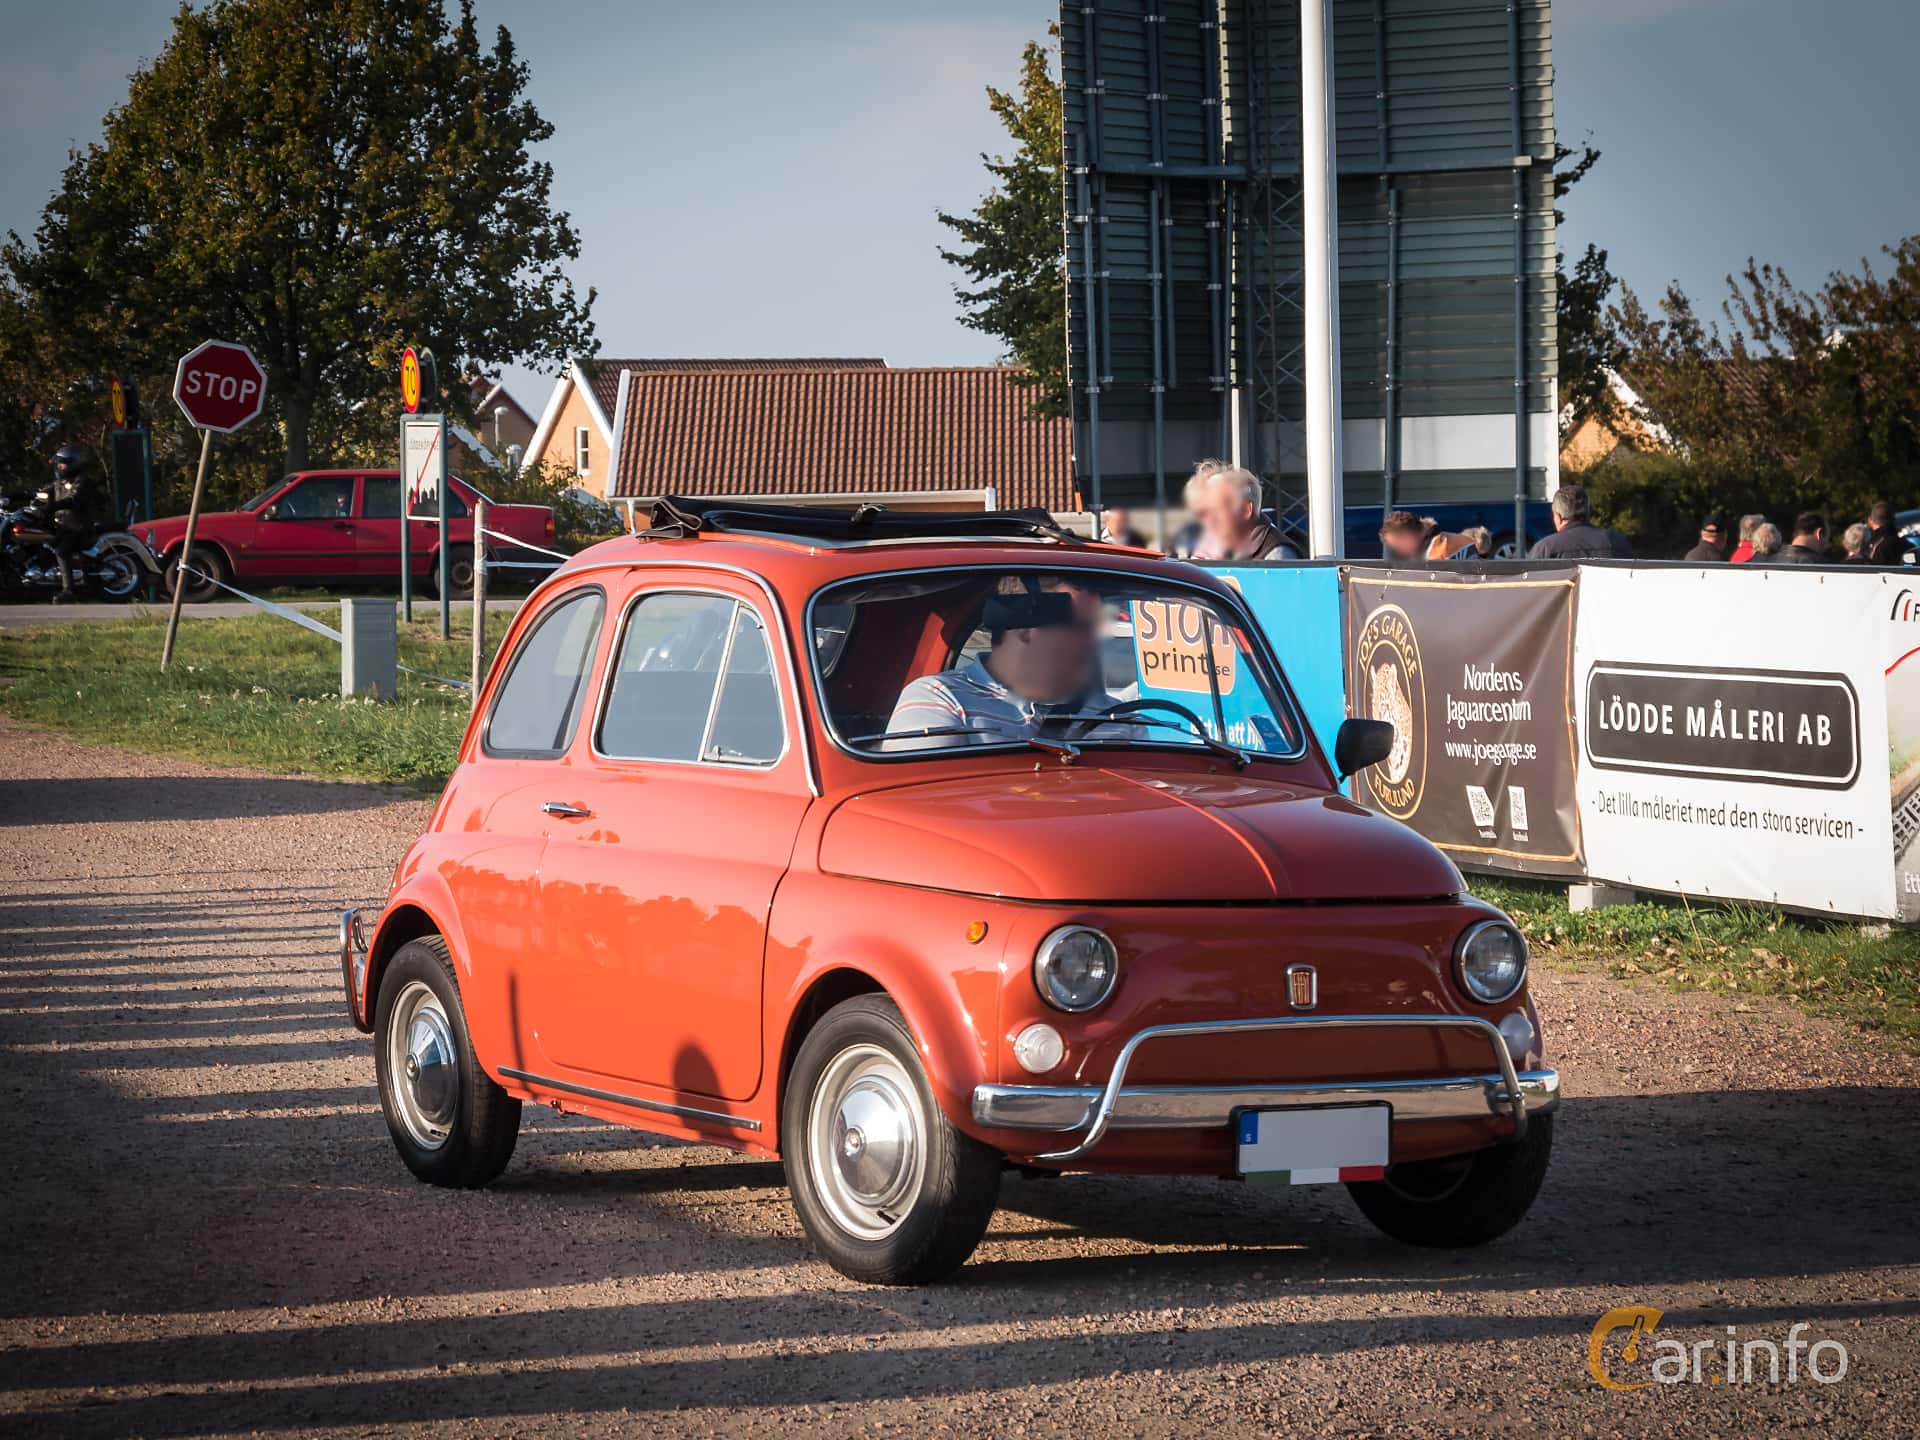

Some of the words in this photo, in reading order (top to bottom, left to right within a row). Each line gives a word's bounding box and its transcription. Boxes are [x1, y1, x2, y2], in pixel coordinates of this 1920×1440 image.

[185, 369, 258, 404] STOP
[1382, 615, 1417, 679] GARAGE
[1463, 662, 1524, 692] Nordens
[1599, 695, 1674, 735] LÖDDE
[1686, 699, 1784, 744] MÅLERI
[1797, 713, 1832, 746] AB
[1598, 790, 1617, 815] Det
[1618, 791, 1639, 817] lilla
[1641, 794, 1694, 824] måleriet
[1696, 801, 1726, 826] med
[1730, 802, 1758, 829] den
[1762, 808, 1792, 833] stora
[1795, 812, 1854, 840] servicen
[1245, 1133, 1252, 1142] S
